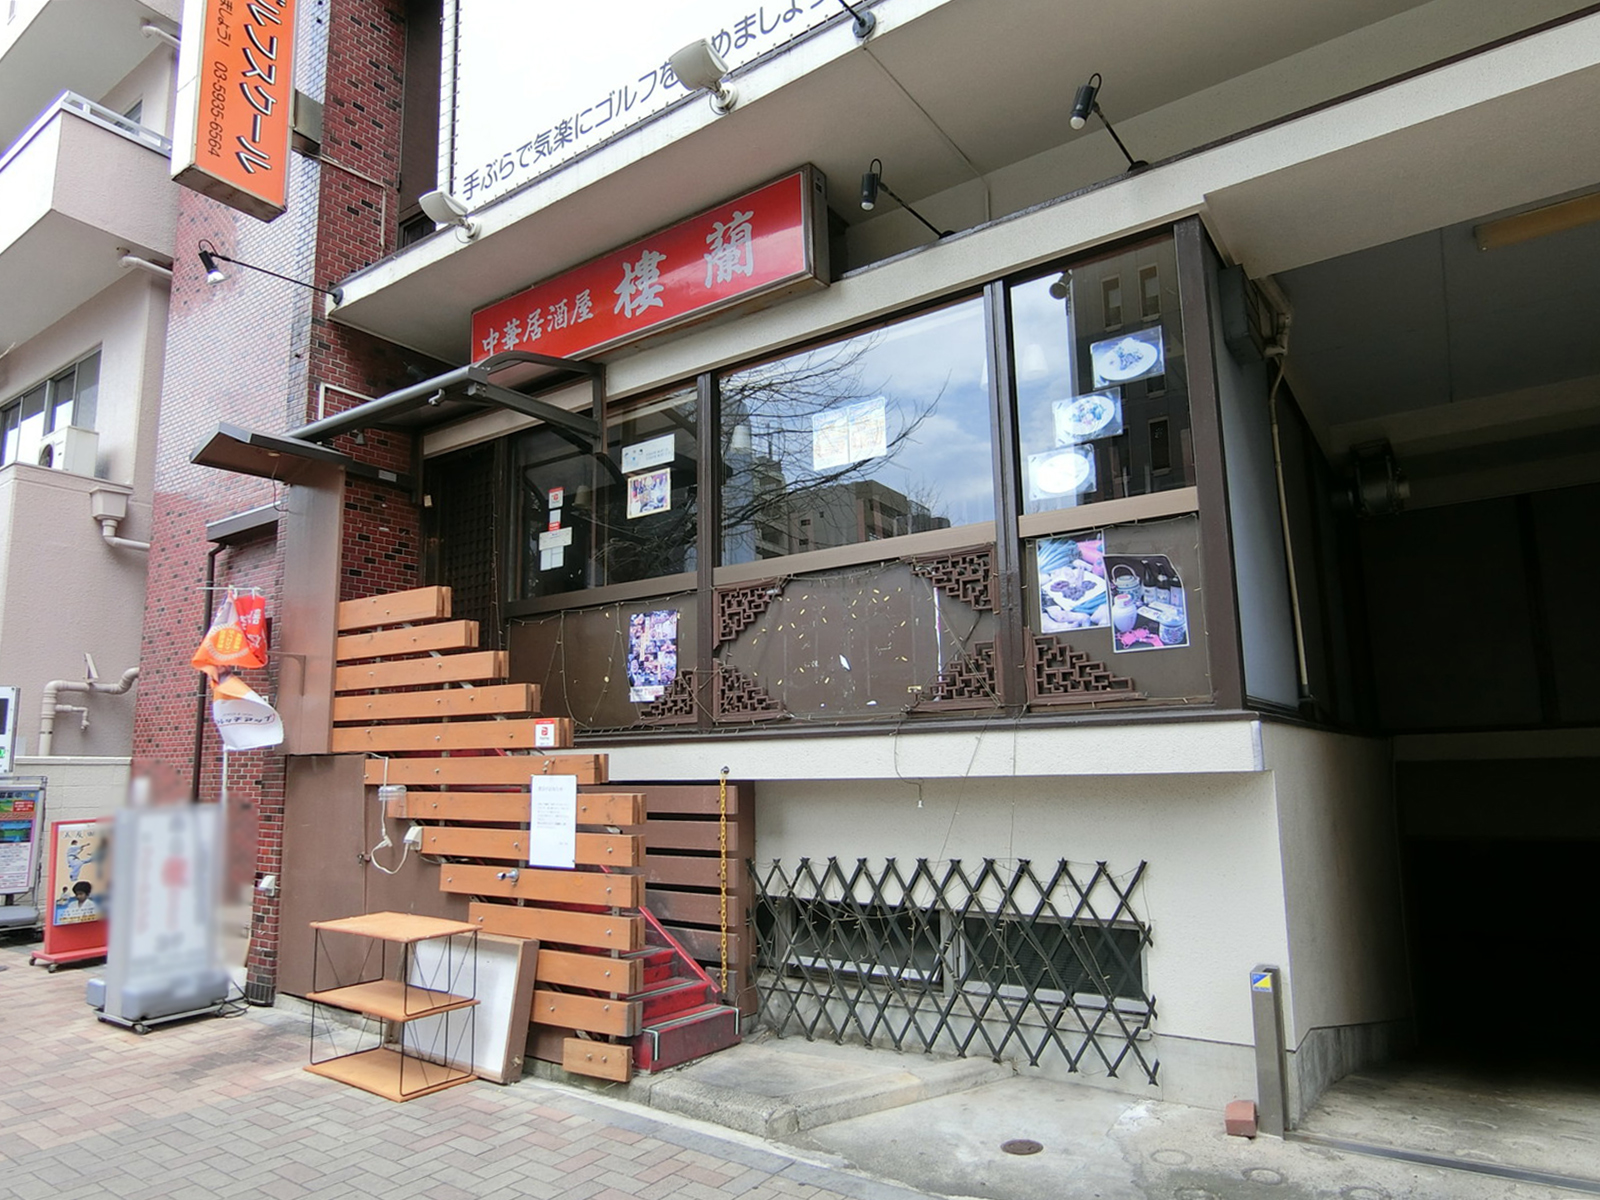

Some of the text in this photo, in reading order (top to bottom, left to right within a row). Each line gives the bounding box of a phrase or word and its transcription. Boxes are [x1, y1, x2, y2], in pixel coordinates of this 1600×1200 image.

[208, 60, 229, 158] 03-5935-6564
[235, 0, 286, 174] ルフスクール
[482, 288, 594, 355] 中華居酒屋
